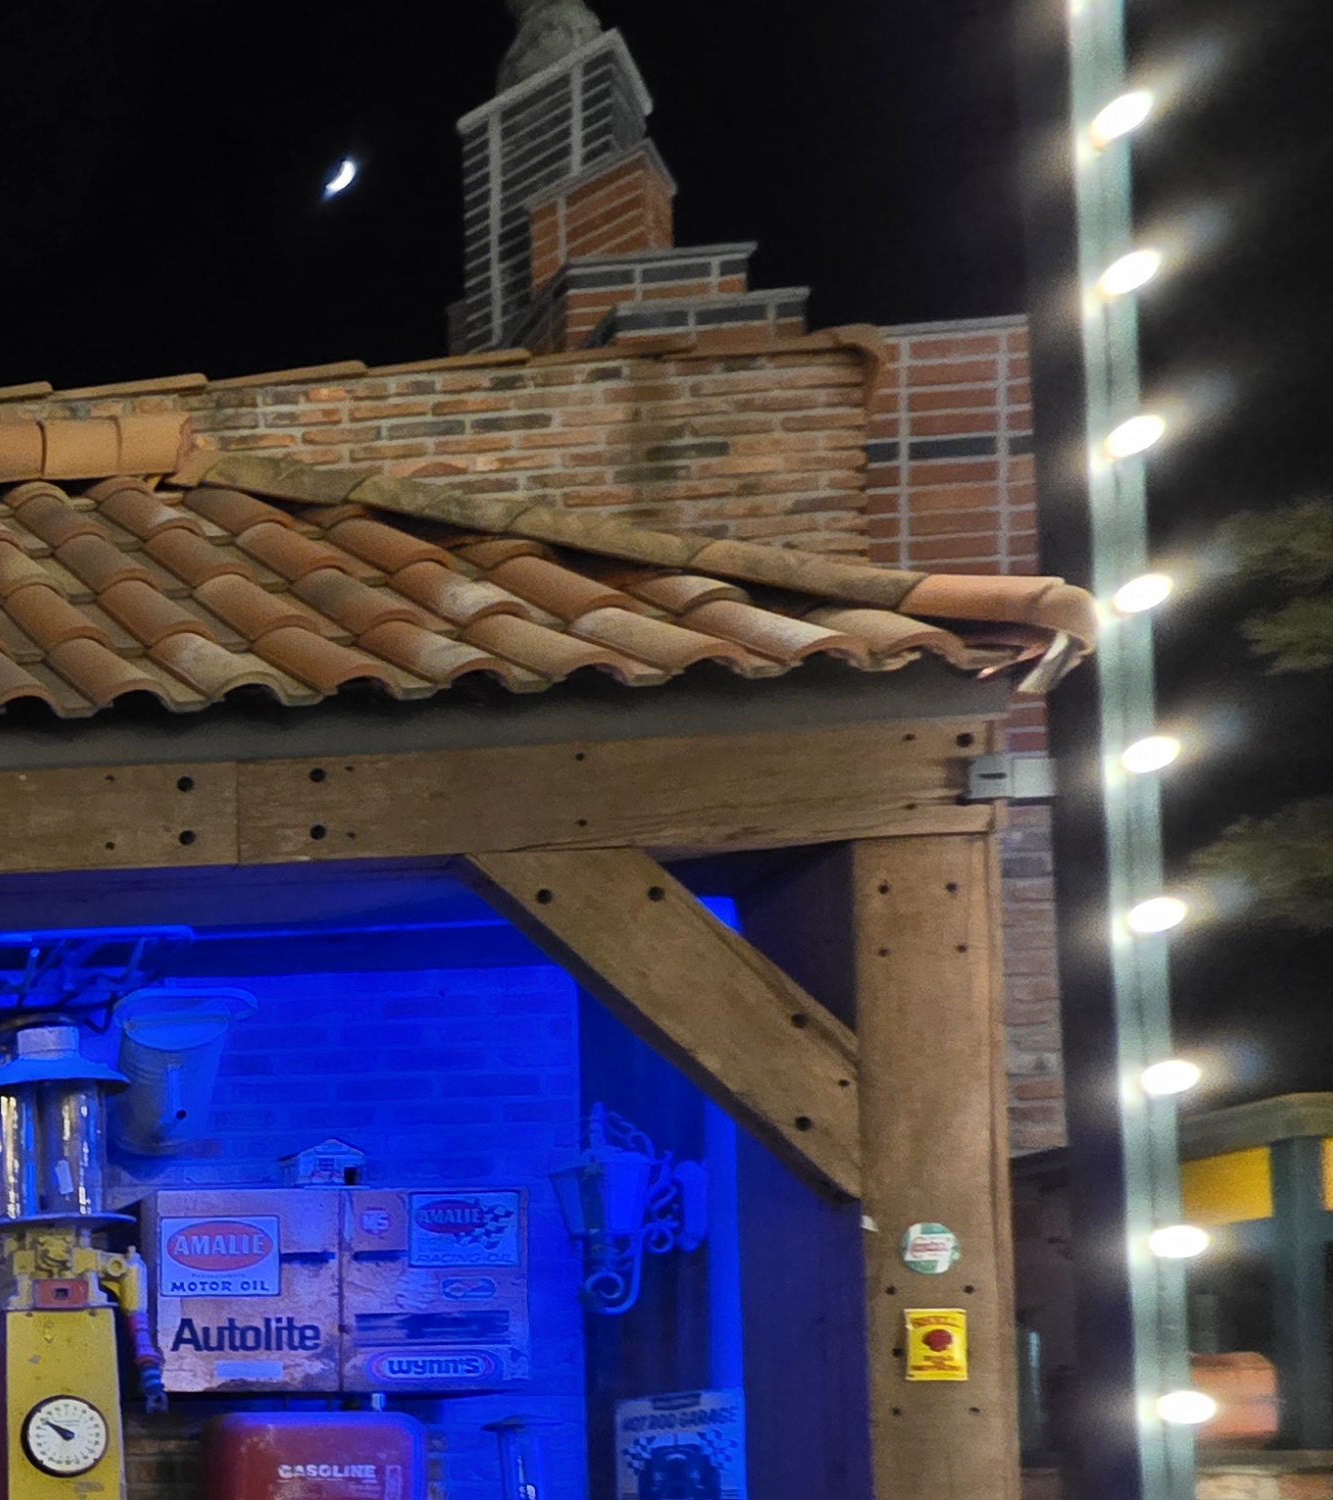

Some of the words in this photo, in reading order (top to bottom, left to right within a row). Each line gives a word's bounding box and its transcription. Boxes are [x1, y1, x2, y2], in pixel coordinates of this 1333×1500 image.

[418, 1208, 482, 1224] AMALIE
[173, 1234, 266, 1256] AMALIE
[170, 1280, 233, 1292] MOTOR
[240, 1280, 270, 1292] OIL
[170, 1316, 322, 1352] Autolite
[277, 1463, 376, 1479] GASOLINE
